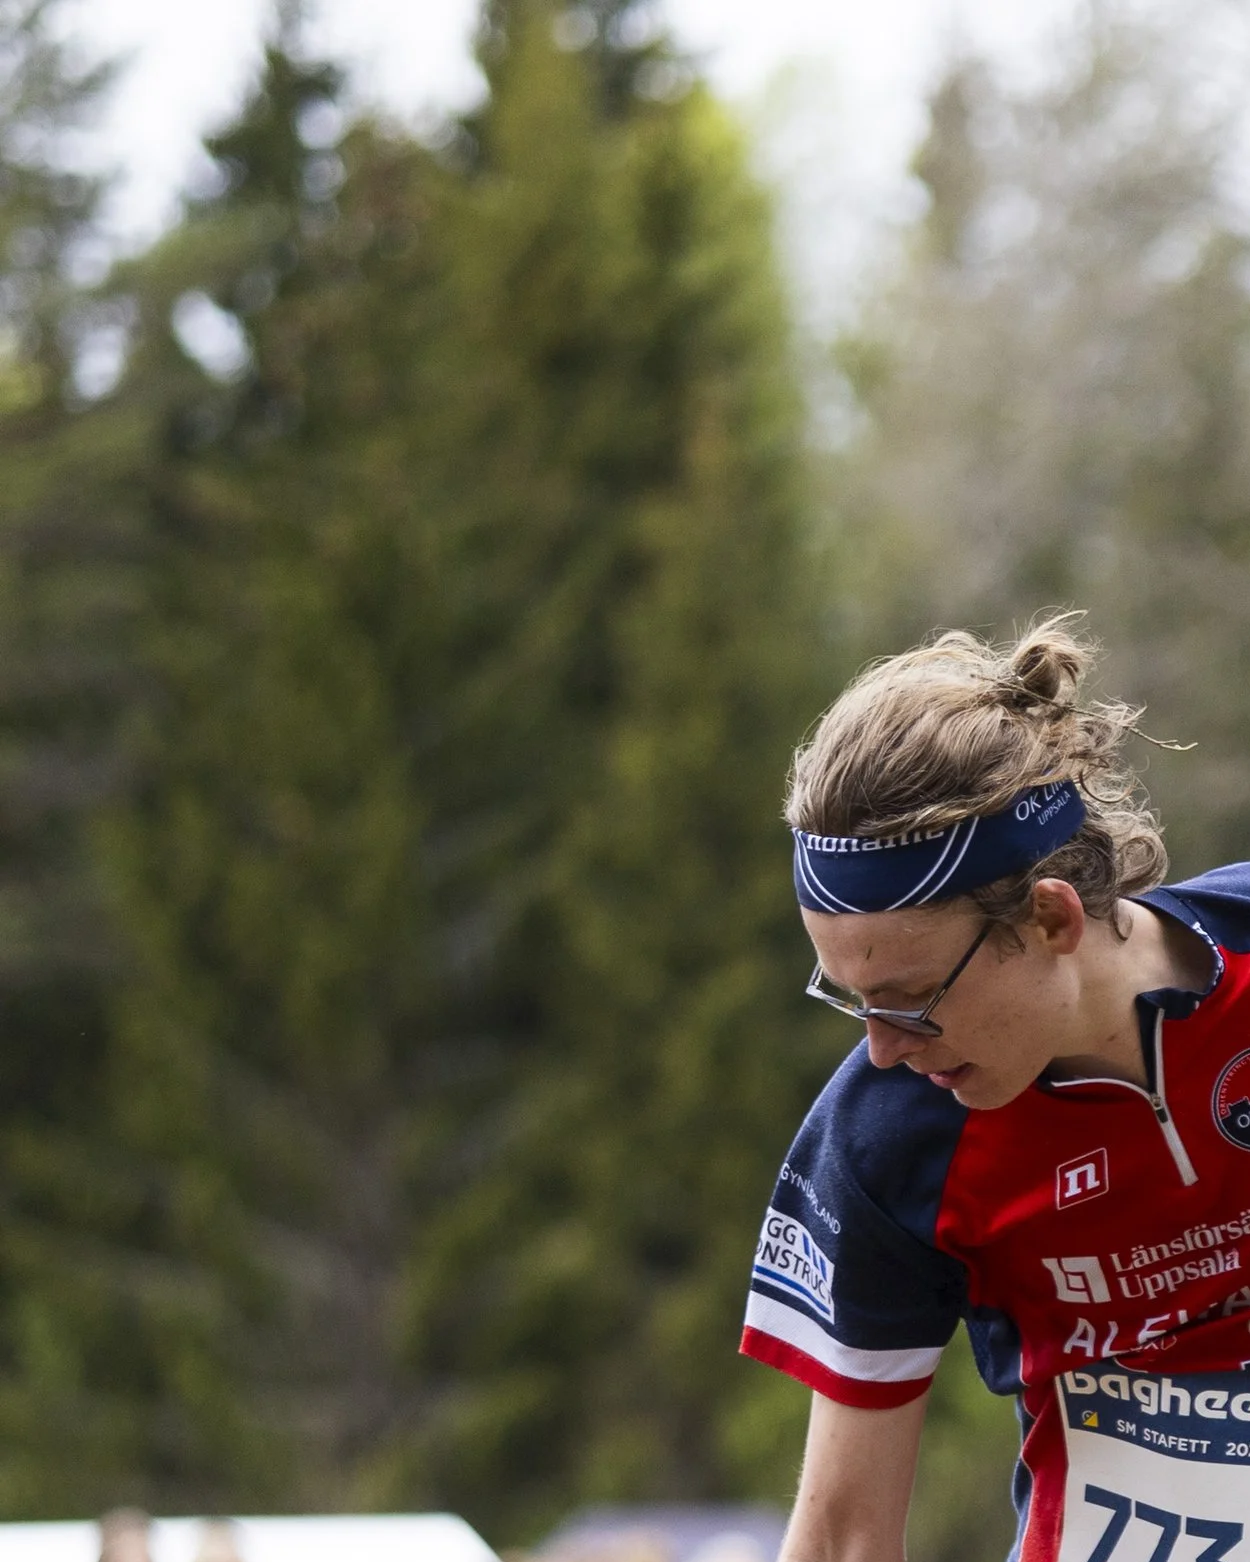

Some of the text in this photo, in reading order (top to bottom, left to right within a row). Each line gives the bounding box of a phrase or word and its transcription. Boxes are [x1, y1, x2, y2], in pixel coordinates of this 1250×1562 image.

[1016, 792, 1042, 821] OK
[1037, 790, 1071, 825] UPPSALA
[1118, 1248, 1242, 1300] Uppsala
[1116, 1419, 1136, 1436] SM
[1143, 1428, 1211, 1454] STAFETT
